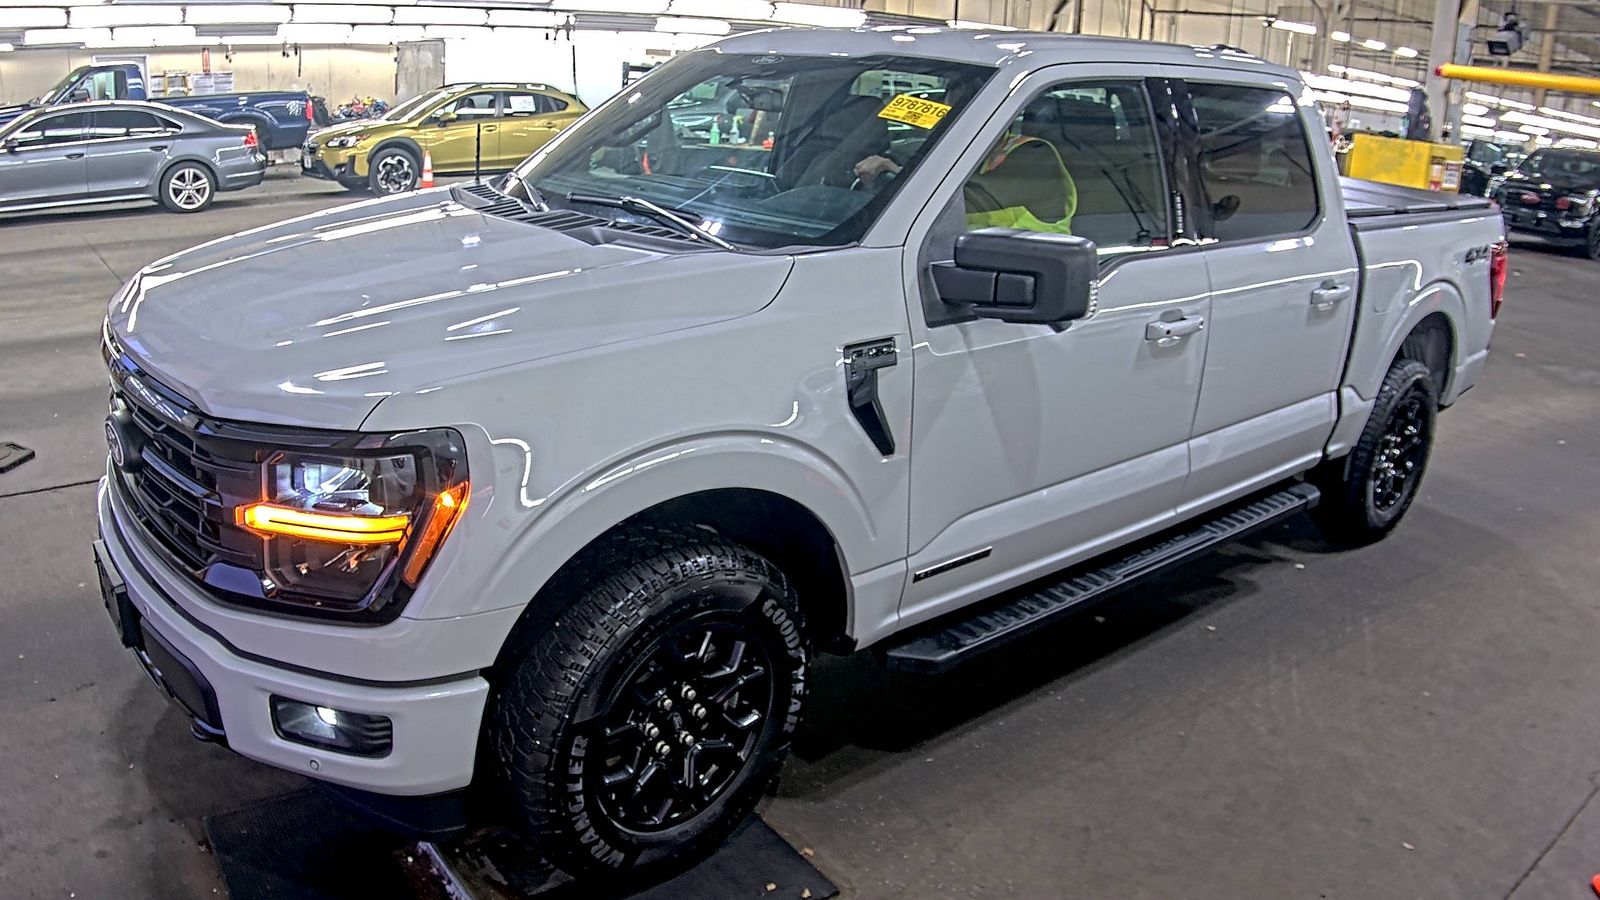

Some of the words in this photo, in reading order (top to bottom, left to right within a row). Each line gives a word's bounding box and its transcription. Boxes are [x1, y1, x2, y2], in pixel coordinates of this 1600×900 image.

[892, 97, 950, 118] 9787816
[762, 598, 806, 734] GOODYEAR
[566, 735, 625, 869] WRANGLER
